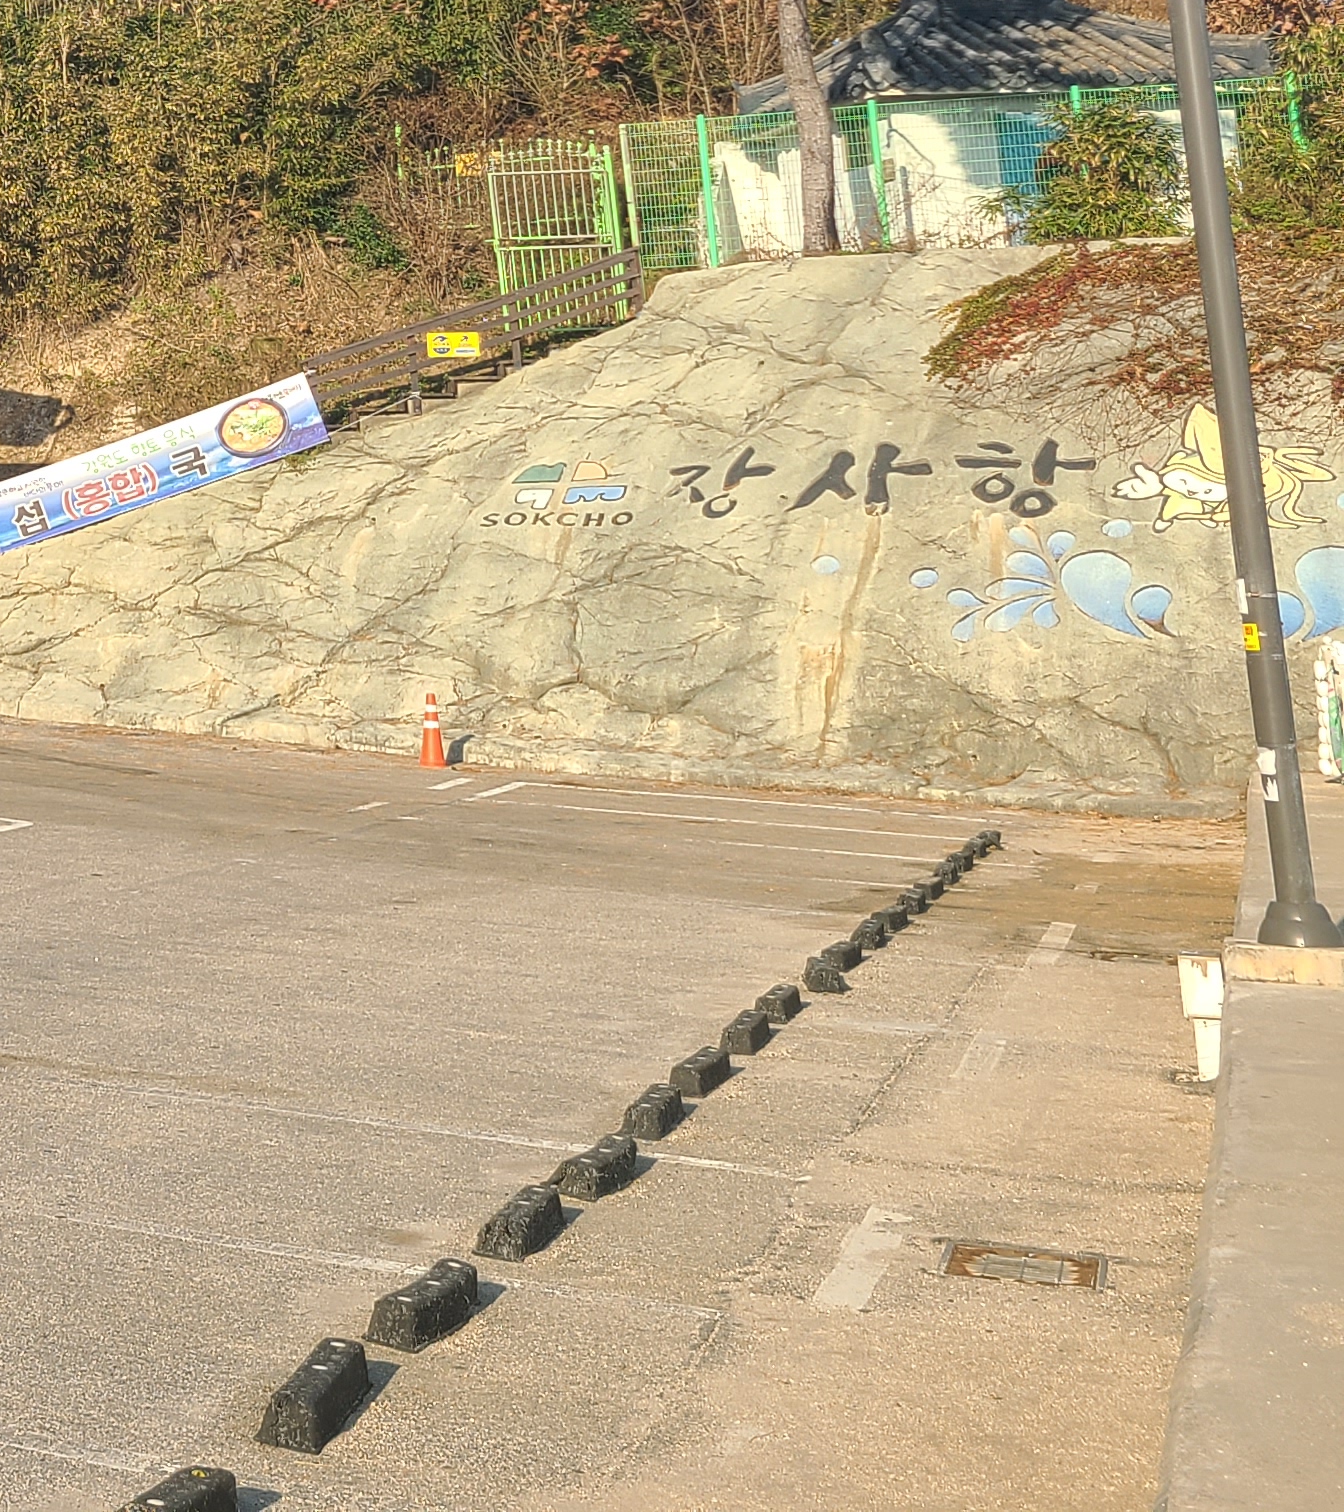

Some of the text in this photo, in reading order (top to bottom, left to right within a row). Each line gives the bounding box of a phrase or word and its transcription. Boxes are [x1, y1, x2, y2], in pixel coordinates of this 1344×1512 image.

[81, 447, 129, 473] 강원도
[163, 424, 196, 447] 음식
[669, 437, 1098, 519] 장사항
[14, 445, 209, 537] 섭 (홍합) 국
[480, 511, 634, 529] SOKCHO
